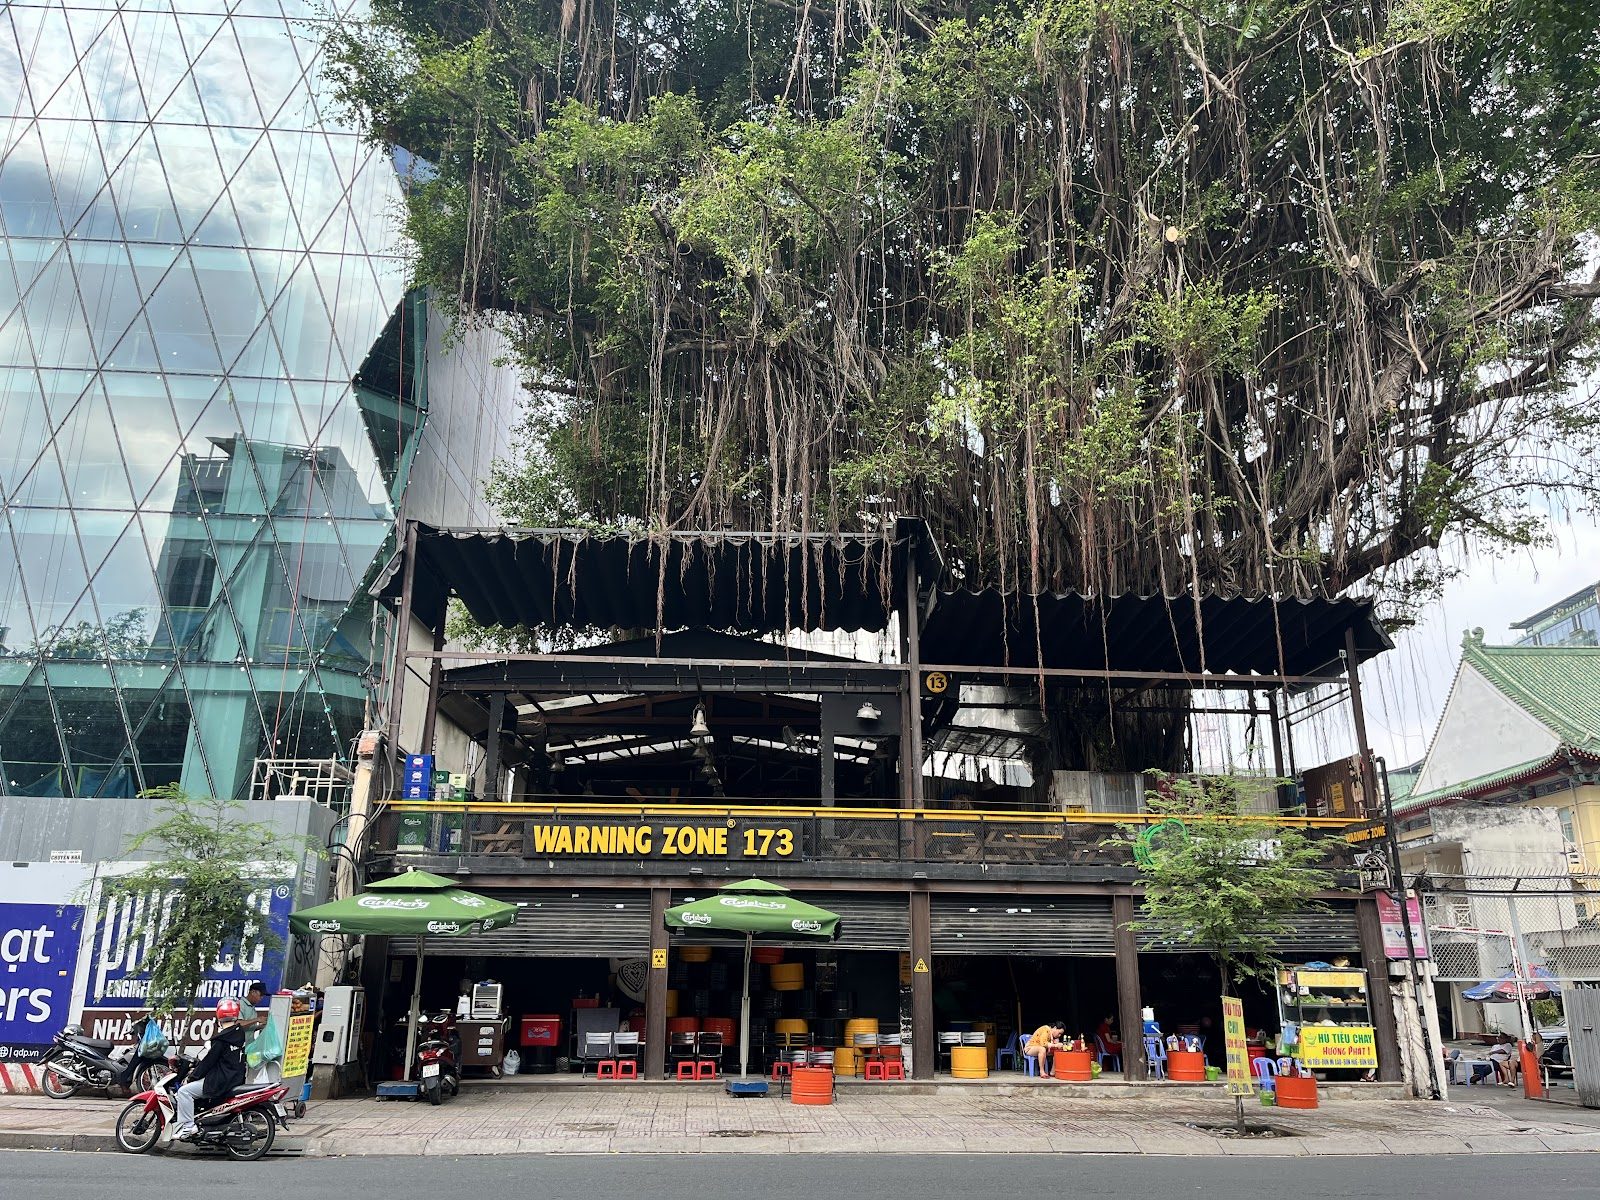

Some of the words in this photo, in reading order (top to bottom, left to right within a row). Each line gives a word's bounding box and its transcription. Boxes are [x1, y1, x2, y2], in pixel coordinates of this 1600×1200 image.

[930, 677, 944, 689] 13
[1370, 825, 1386, 838] ZONE
[533, 825, 652, 854] WARNING
[661, 826, 728, 855] ZONE
[743, 828, 794, 856] 173
[357, 896, 431, 910] Carlsberg
[682, 912, 712, 924] Carlsberg
[308, 919, 341, 932] Carlsberg
[427, 921, 460, 933] Carlsberg
[791, 920, 821, 931] Carlsberg
[0, 988, 52, 1023] rs
[93, 1013, 132, 1041] NHÀ
[1352, 1034, 1372, 1044] CHAY
[13, 1048, 39, 1058] qdp.vn
